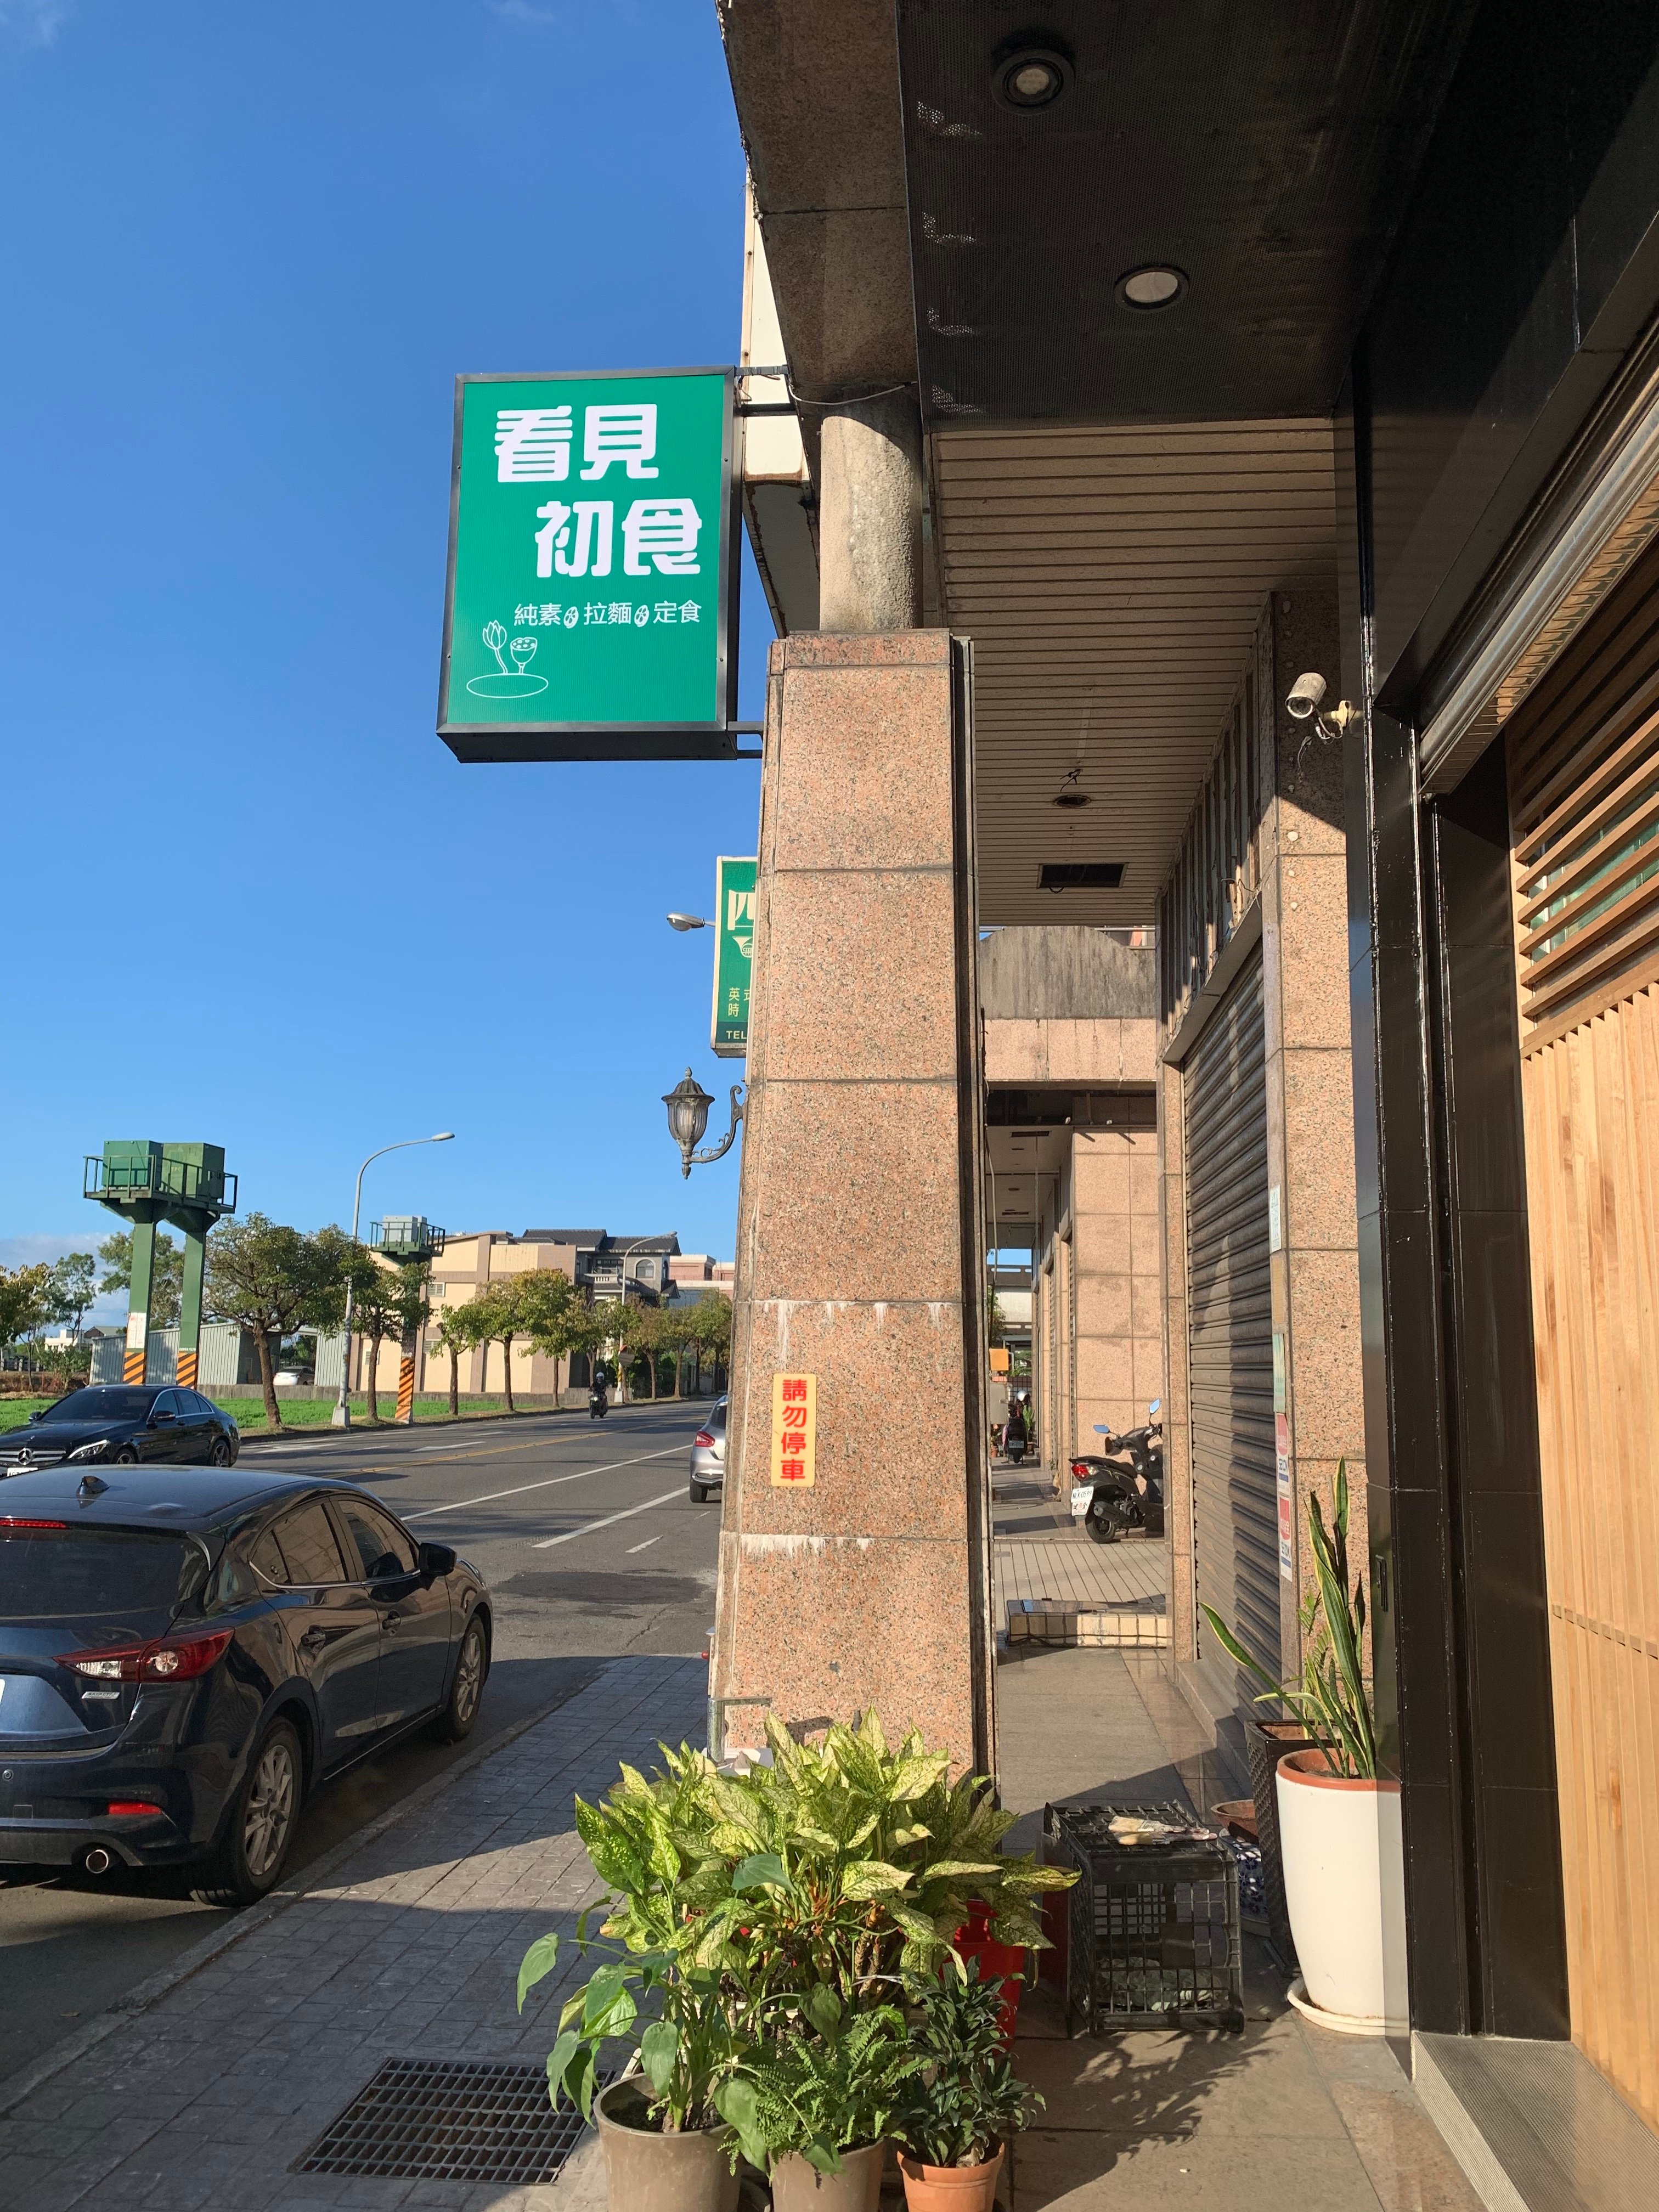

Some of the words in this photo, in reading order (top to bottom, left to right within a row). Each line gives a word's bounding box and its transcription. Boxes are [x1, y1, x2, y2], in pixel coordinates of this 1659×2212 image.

[494, 404, 659, 482] 看見
[534, 498, 702, 578] 初食
[515, 603, 561, 625] 純素
[584, 602, 631, 624] 拉麵
[653, 600, 701, 623] 定食
[781, 1379, 807, 1481] 請勿停車
